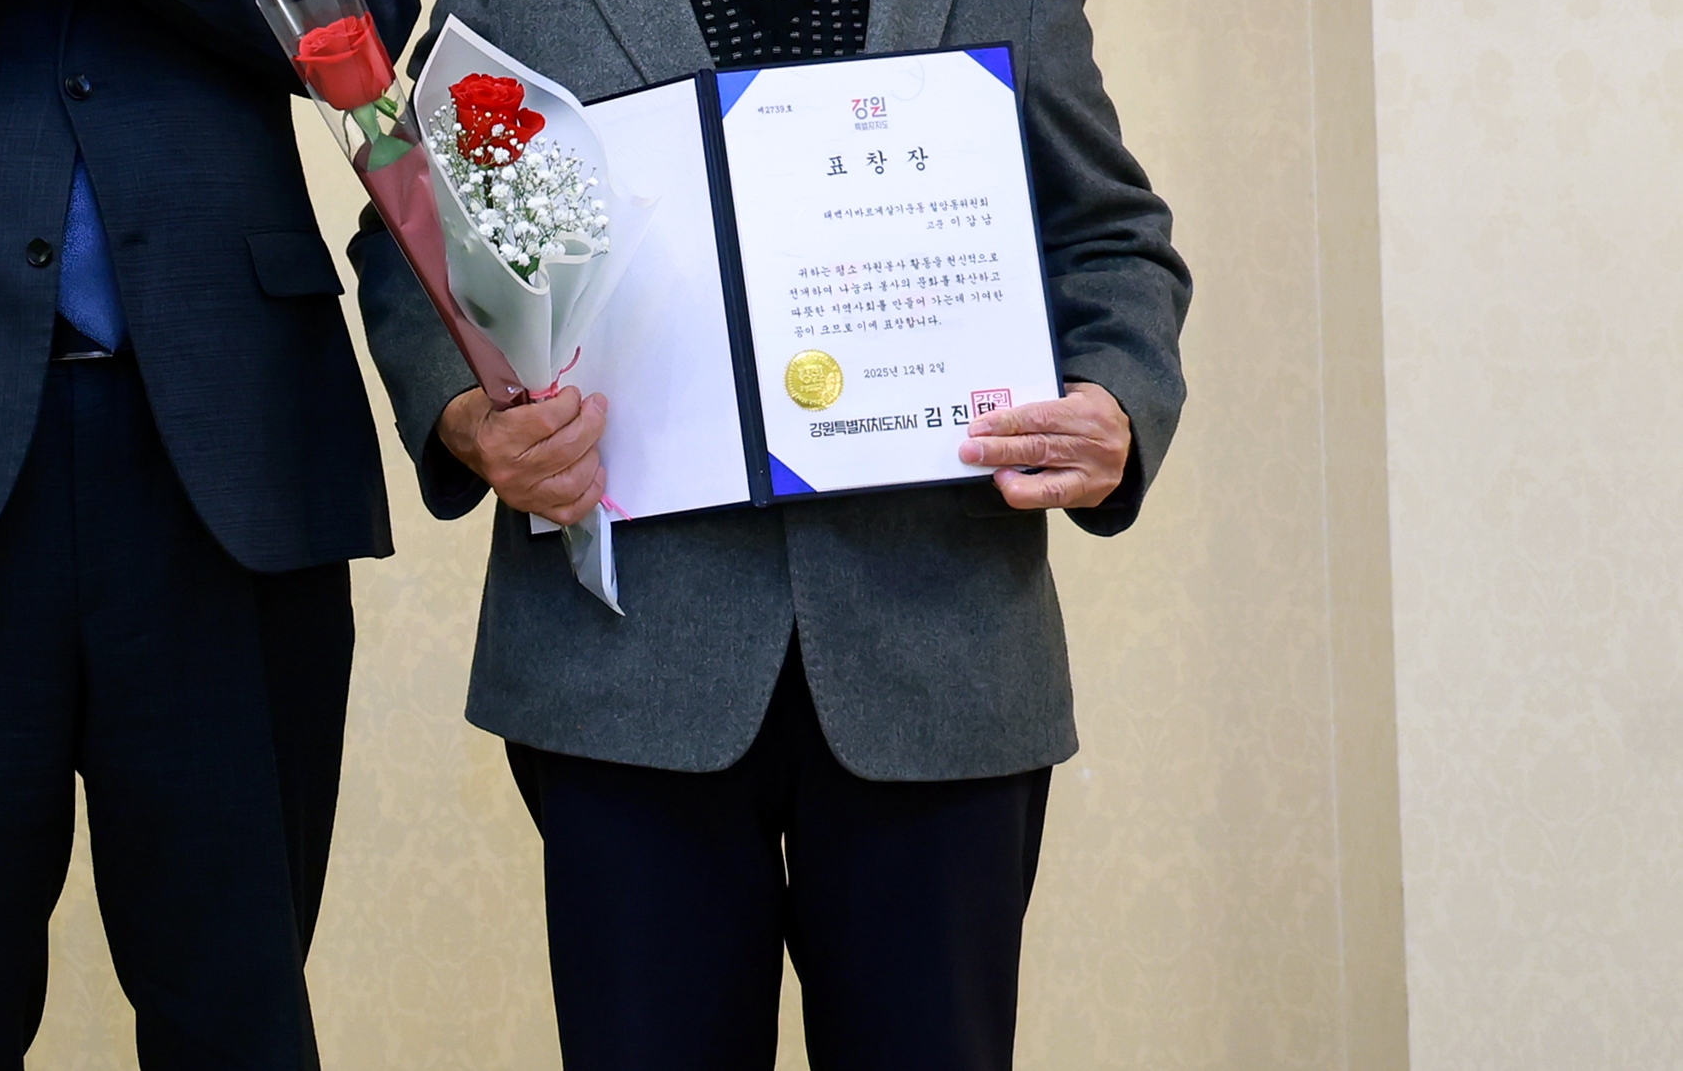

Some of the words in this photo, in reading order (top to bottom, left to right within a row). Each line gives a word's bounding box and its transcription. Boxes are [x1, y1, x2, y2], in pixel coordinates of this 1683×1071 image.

[851, 96, 887, 120] 강원
[798, 267, 831, 278] 귀하는
[835, 264, 858, 277] 평소
[862, 259, 906, 273] 자원봉사
[789, 285, 832, 300] 전개하여
[839, 281, 873, 294] 나눔과
[879, 278, 910, 292] 봉사의
[917, 274, 950, 289] 문화를
[791, 305, 825, 318] 따뜻한
[831, 299, 887, 314] 지역사회를
[892, 296, 926, 310] 만들어
[931, 293, 964, 306] 가는데
[971, 289, 1003, 303] 기여한
[794, 325, 814, 338] 공이
[820, 323, 853, 335] 크므로
[857, 320, 877, 331] 이에
[883, 315, 942, 330] 표창합니다.
[863, 365, 898, 379] 2025년
[903, 363, 924, 375] 12월
[929, 361, 945, 373] 2일
[809, 414, 918, 438] 강원특별자치도지사
